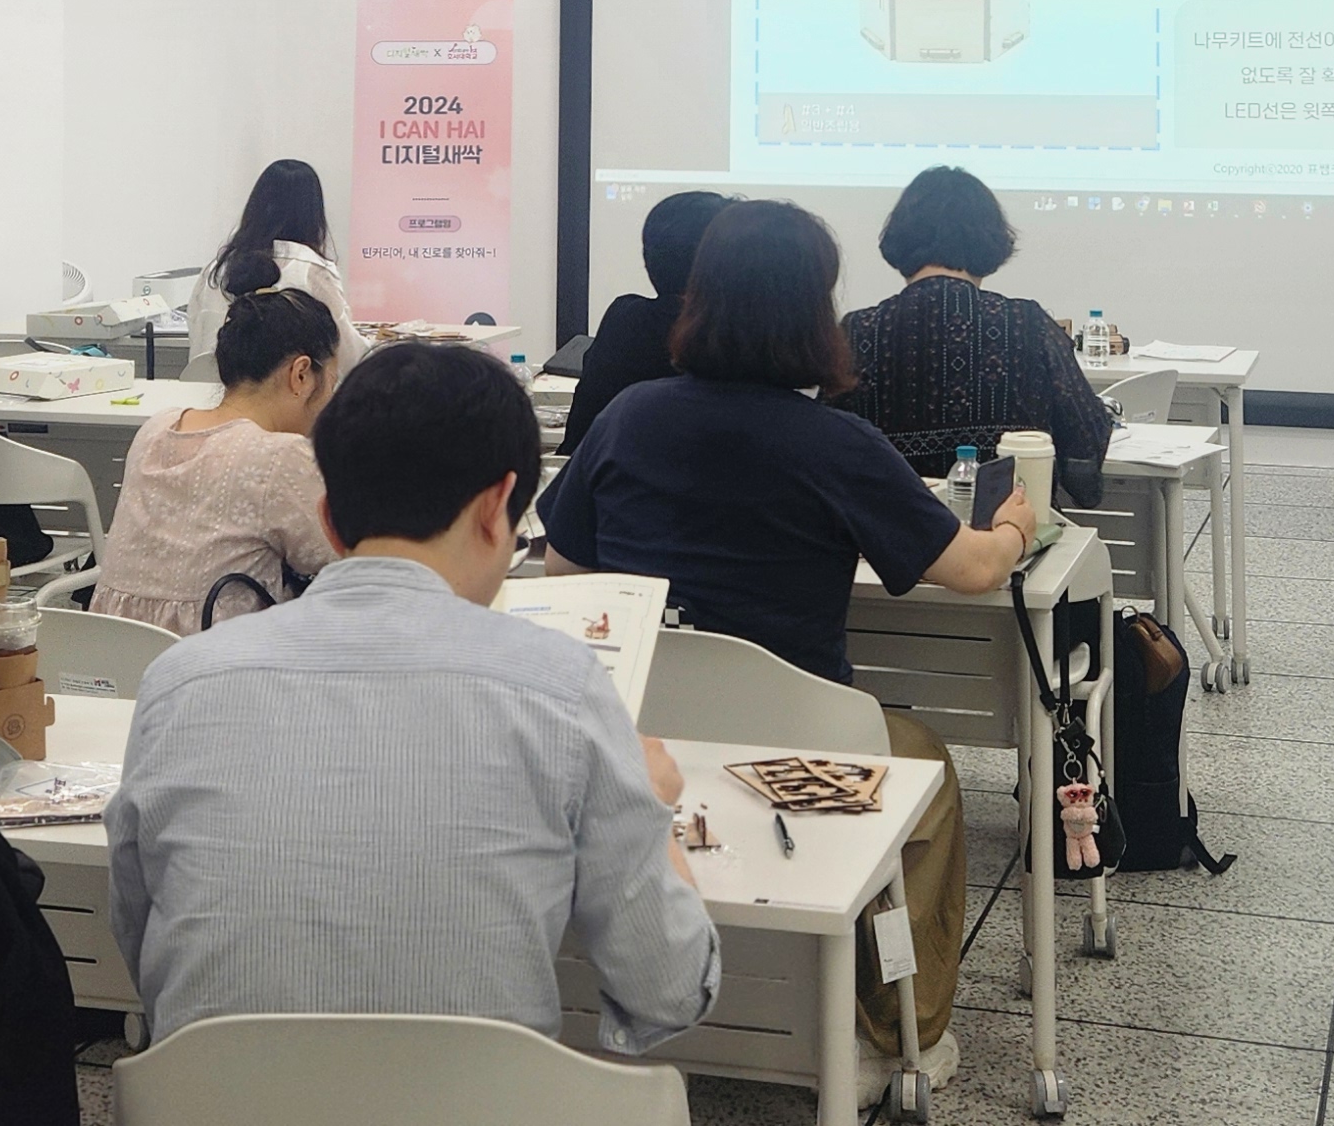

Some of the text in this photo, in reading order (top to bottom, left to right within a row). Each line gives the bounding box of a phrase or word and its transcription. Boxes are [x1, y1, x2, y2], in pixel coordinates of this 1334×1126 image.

[1193, 30, 1283, 50] 나무키트에
[1240, 67, 1294, 85] 없도록
[1298, 67, 1316, 85] 잘
[403, 96, 464, 115] 2024
[1224, 102, 1298, 121] LED선은
[380, 120, 485, 139] I CAN HAI
[382, 144, 483, 165] 디지털새싹
[408, 247, 419, 259] 내
[422, 247, 452, 259] 진로를
